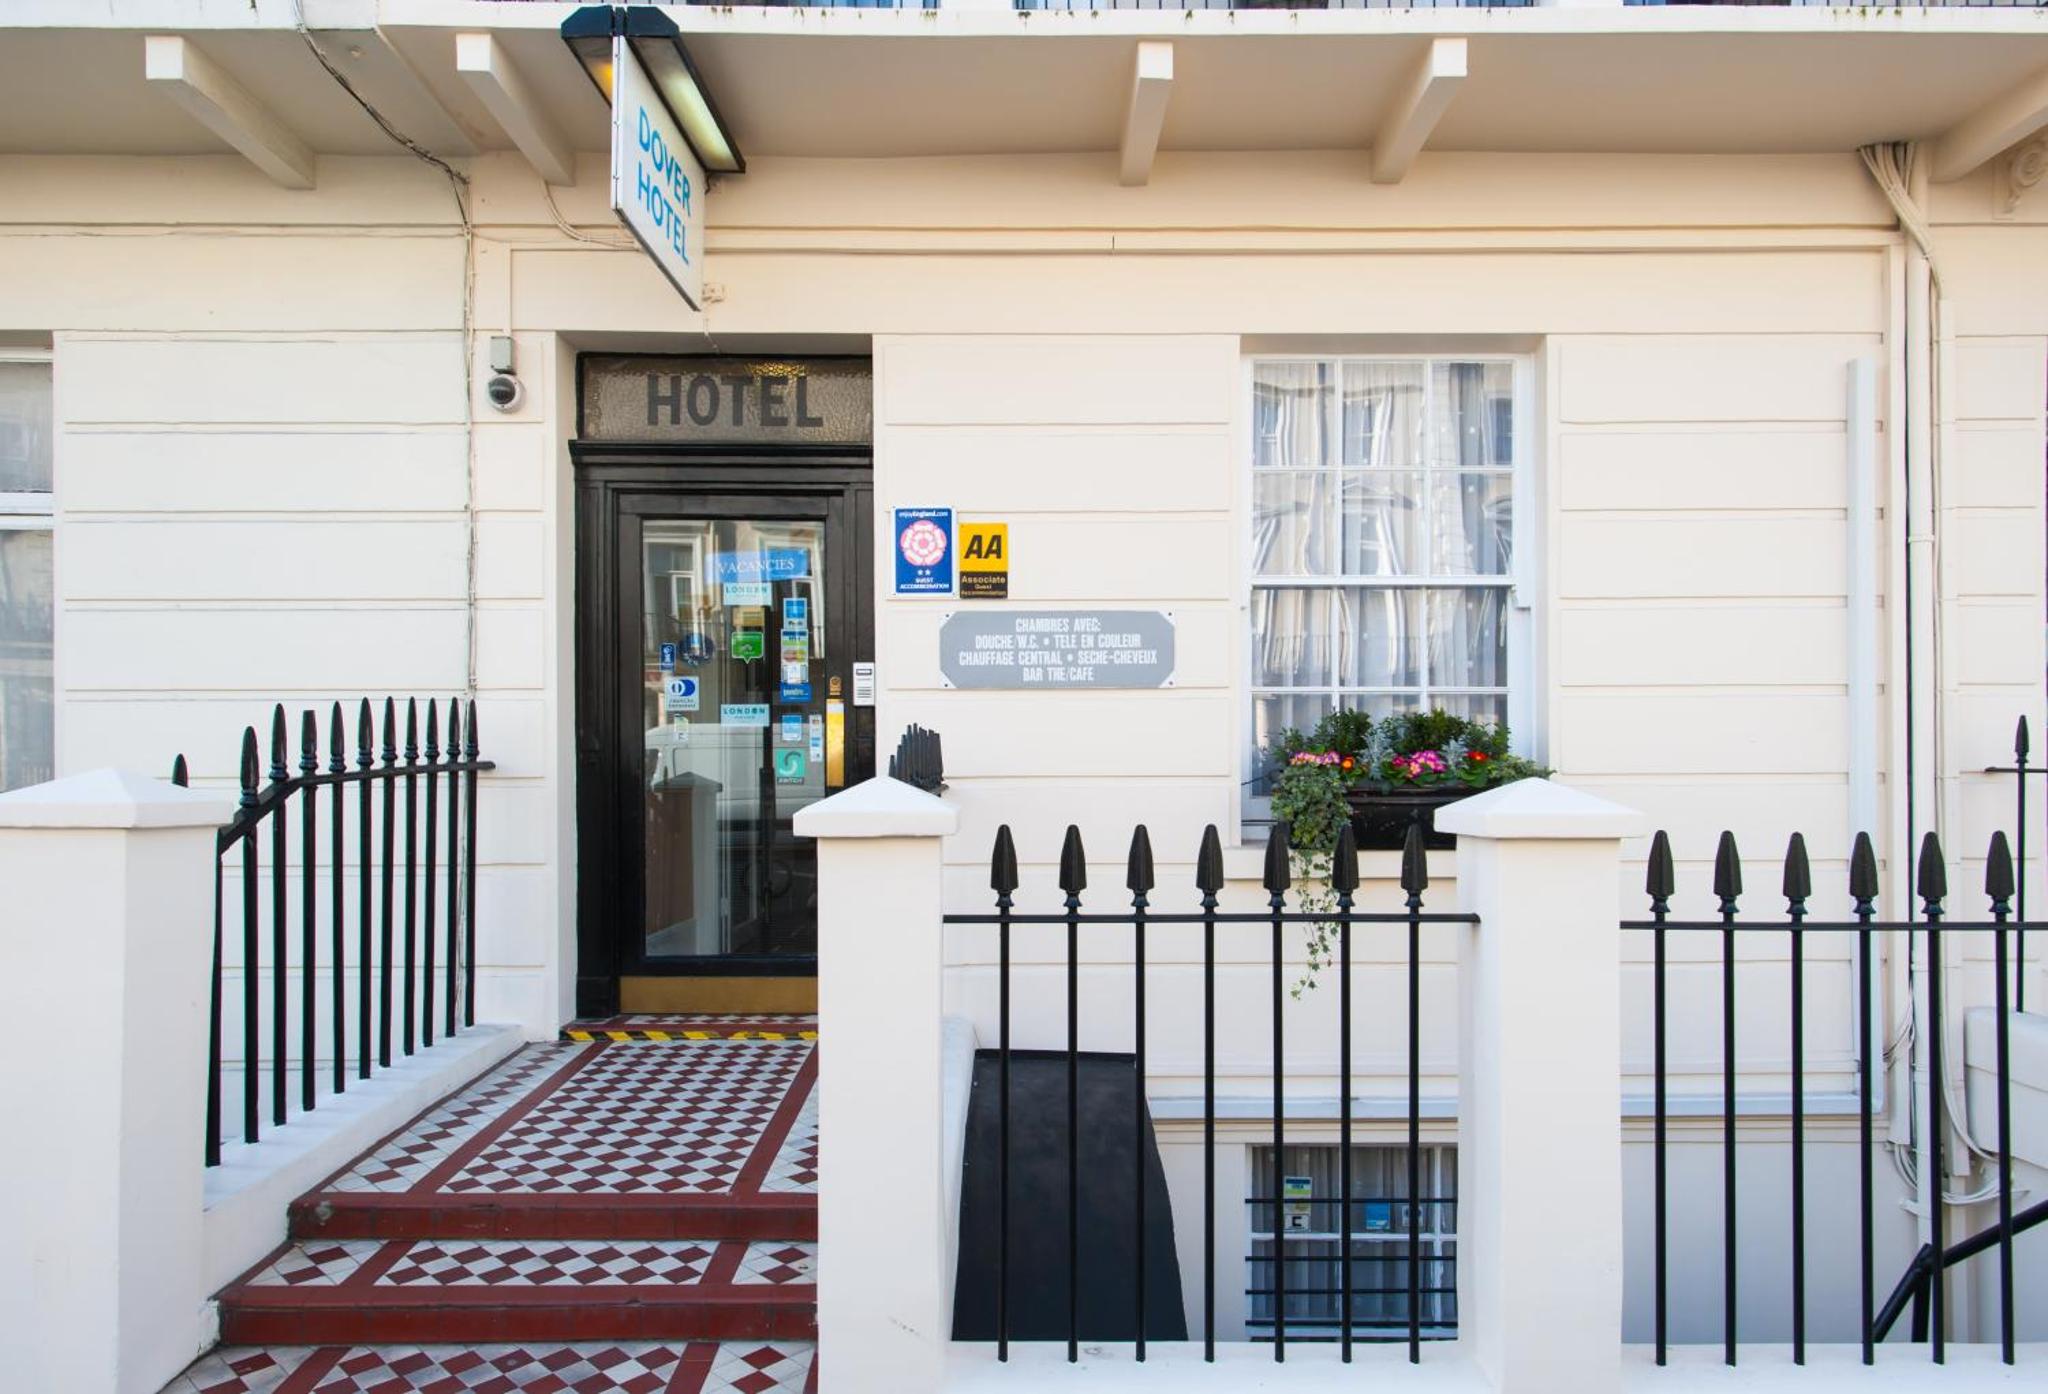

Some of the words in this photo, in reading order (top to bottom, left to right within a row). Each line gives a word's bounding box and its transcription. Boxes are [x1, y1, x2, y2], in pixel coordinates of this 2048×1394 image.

[639, 105, 690, 217] DOVER
[638, 161, 689, 264] HOTEL
[648, 374, 824, 428] HOTEL
[963, 534, 1002, 559] AA
[718, 557, 795, 574] VACANCIES
[1015, 618, 1069, 632] CHAMBRES
[1074, 618, 1101, 632] AVEC:
[1053, 634, 1077, 649] TELE
[1081, 634, 1094, 648] EN
[1098, 634, 1141, 648] COULEUR
[959, 651, 1014, 666] CHAUFFAGE
[1018, 650, 1062, 665] CENTRAL
[1078, 650, 1157, 665] SECHE-CHEVEUX
[1023, 667, 1043, 682] BAR
